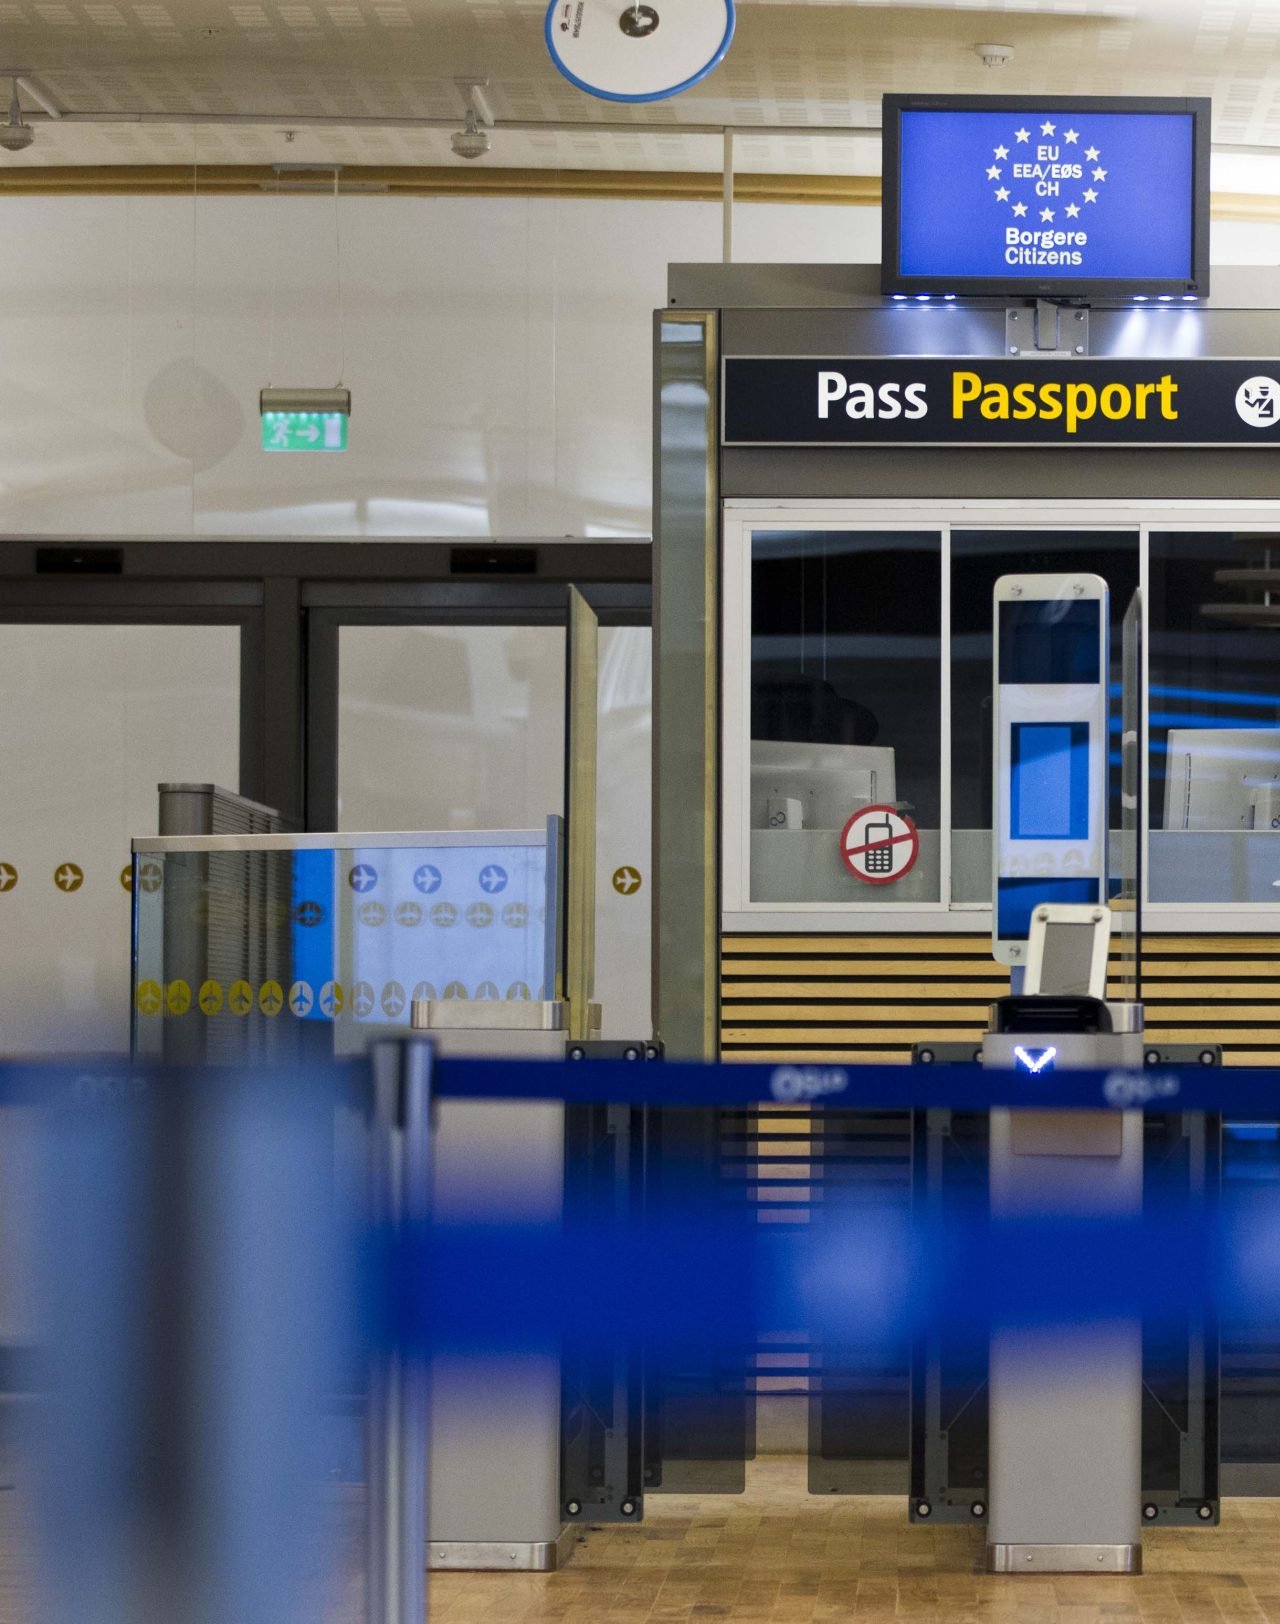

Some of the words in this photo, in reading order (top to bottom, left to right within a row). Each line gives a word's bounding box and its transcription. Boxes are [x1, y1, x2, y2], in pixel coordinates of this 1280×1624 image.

[1037, 145, 1059, 161] EU
[1013, 163, 1083, 181] EEA/EØS
[1035, 181, 1060, 197] CH
[1005, 227, 1088, 249] Borgere
[1004, 246, 1083, 266] Citizens
[818, 371, 928, 420] Pass
[952, 371, 1178, 433] Passport
